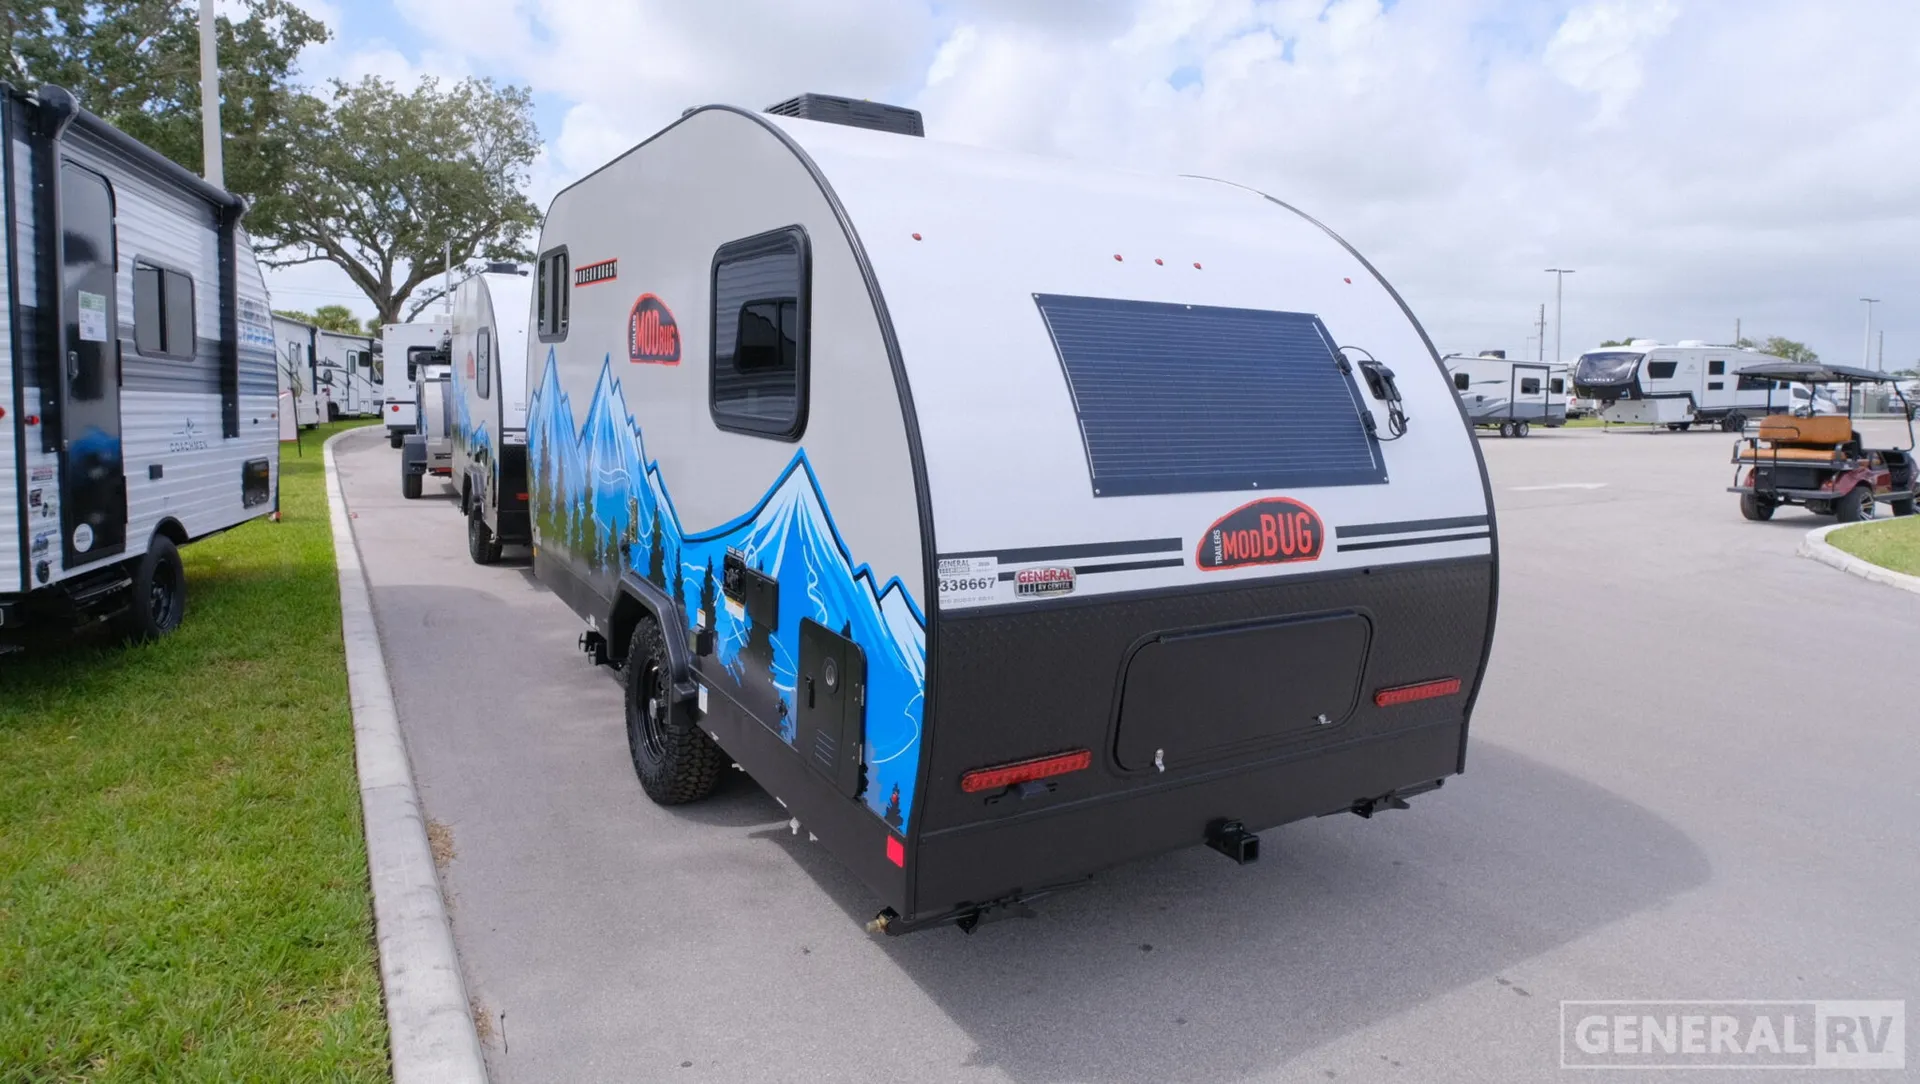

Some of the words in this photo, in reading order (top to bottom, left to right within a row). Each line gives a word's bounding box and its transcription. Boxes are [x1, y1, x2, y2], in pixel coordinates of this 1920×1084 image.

[1214, 529, 1222, 565] TRAILERS
[1018, 569, 1073, 584] GENERAL
[940, 577, 996, 592] 338667
[1038, 583, 1047, 591] RV
[1047, 582, 1070, 590] CENTER
